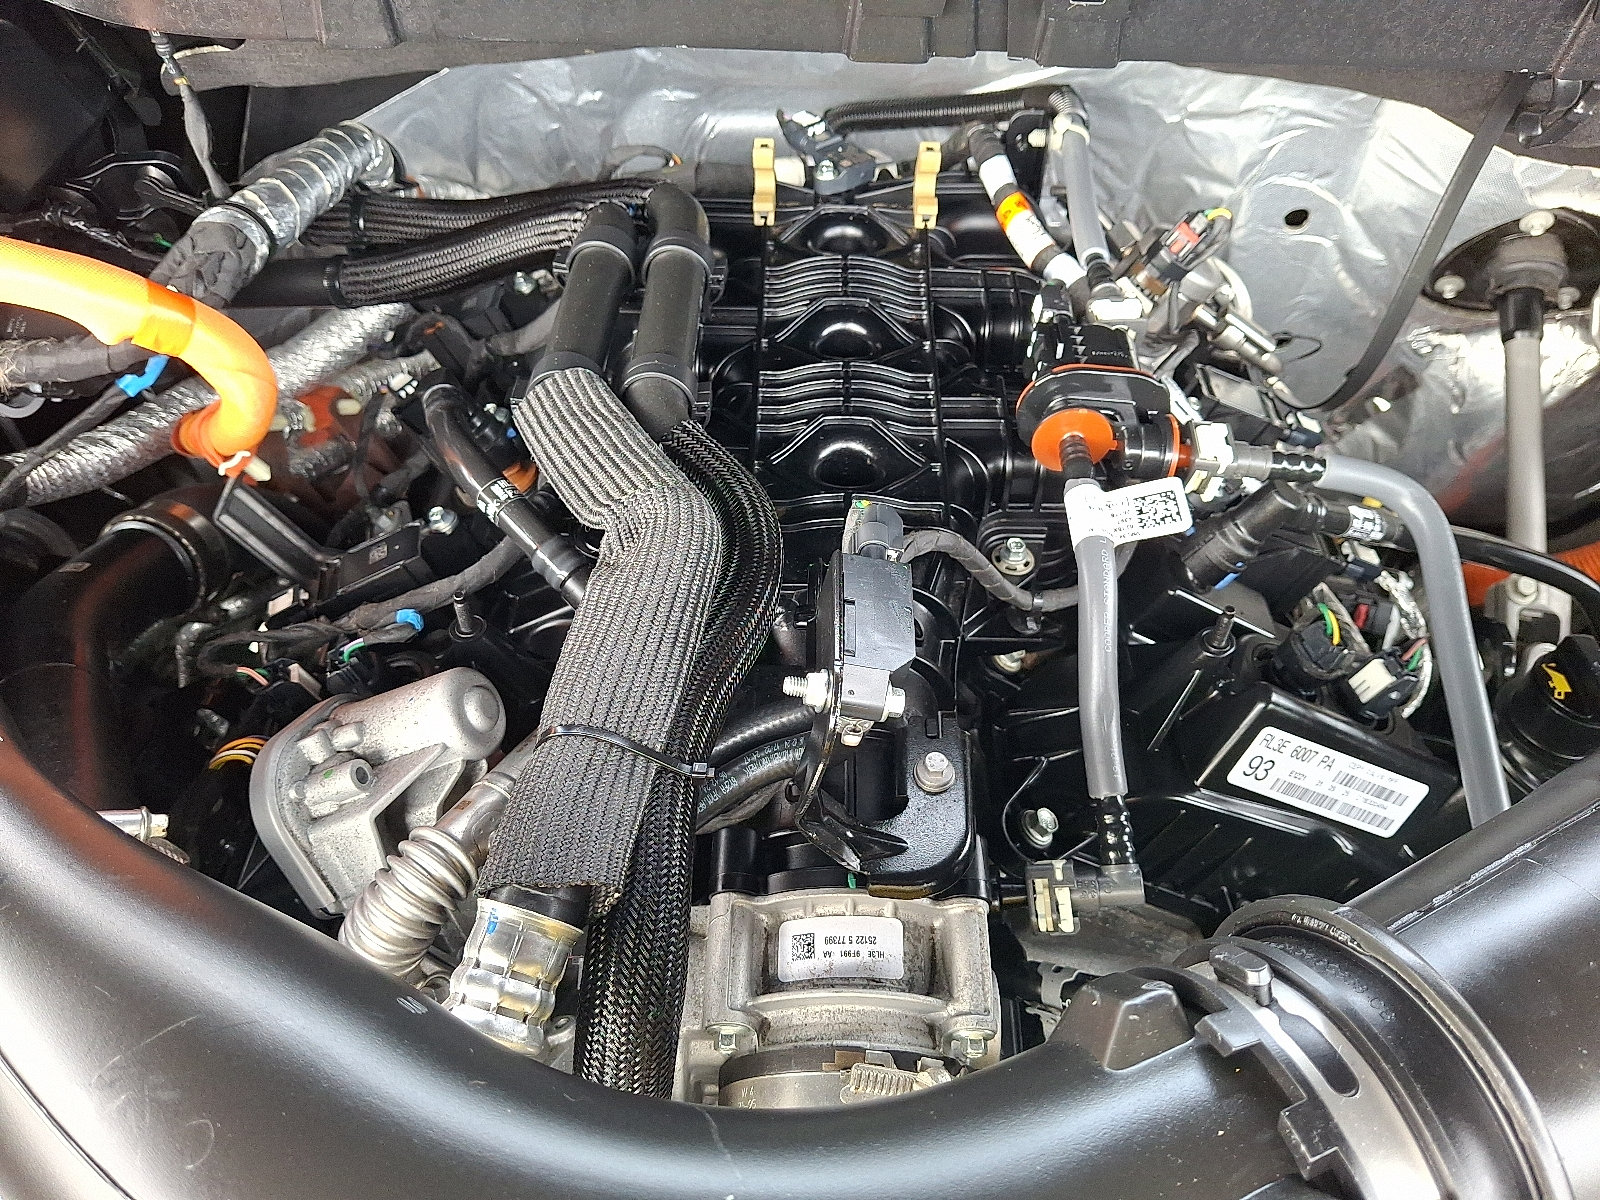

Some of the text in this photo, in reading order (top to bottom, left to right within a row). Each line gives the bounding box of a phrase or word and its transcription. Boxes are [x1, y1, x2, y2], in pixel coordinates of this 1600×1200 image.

[1290, 745, 1319, 763] 6007
[1317, 755, 1336, 771] PA
[1242, 755, 1275, 781] 93
[848, 935, 853, 945] 5
[855, 935, 877, 945] 25122
[840, 950, 861, 958] 9F991
[867, 950, 885, 959] HL3E
